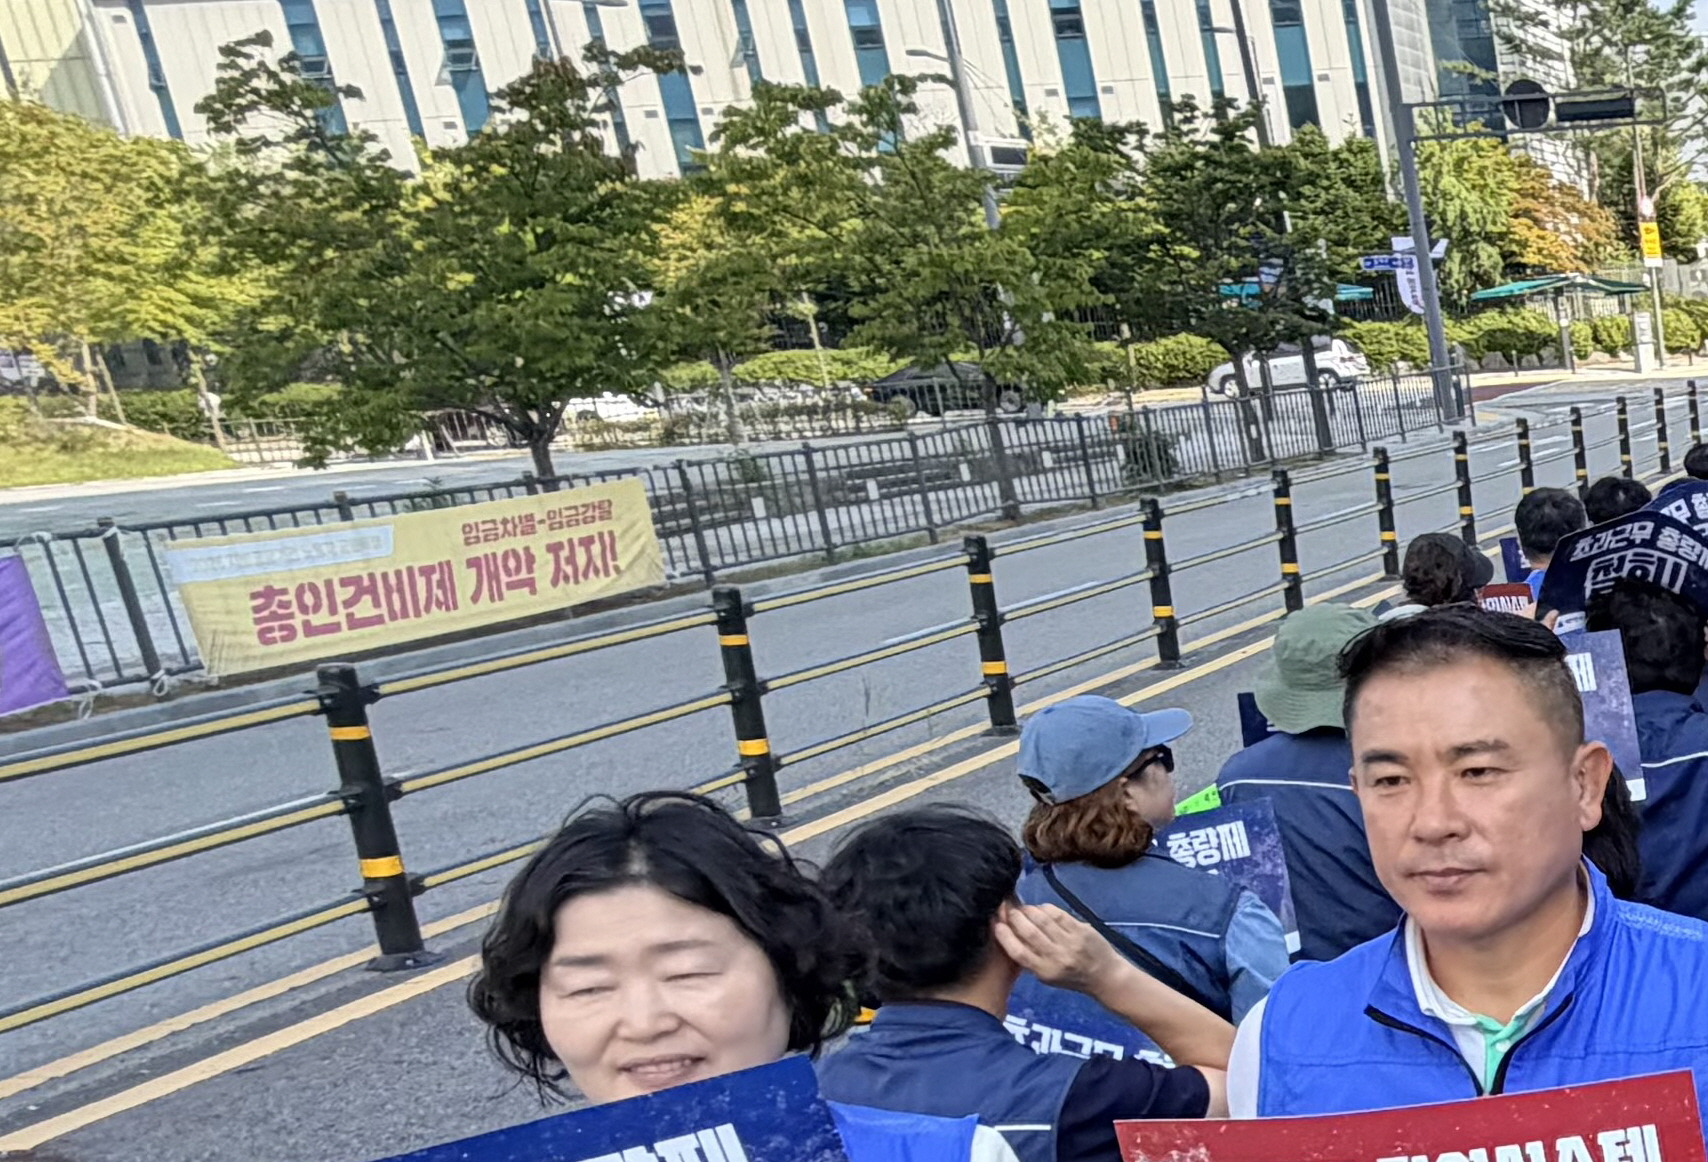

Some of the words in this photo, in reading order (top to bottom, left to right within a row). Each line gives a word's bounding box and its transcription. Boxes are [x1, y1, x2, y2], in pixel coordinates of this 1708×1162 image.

[1569, 520, 1655, 563] 초과근무
[249, 560, 459, 647] 총인건비제
[465, 546, 538, 608] 개악
[545, 530, 622, 590] 저지!
[1167, 820, 1251, 870] 총량제
